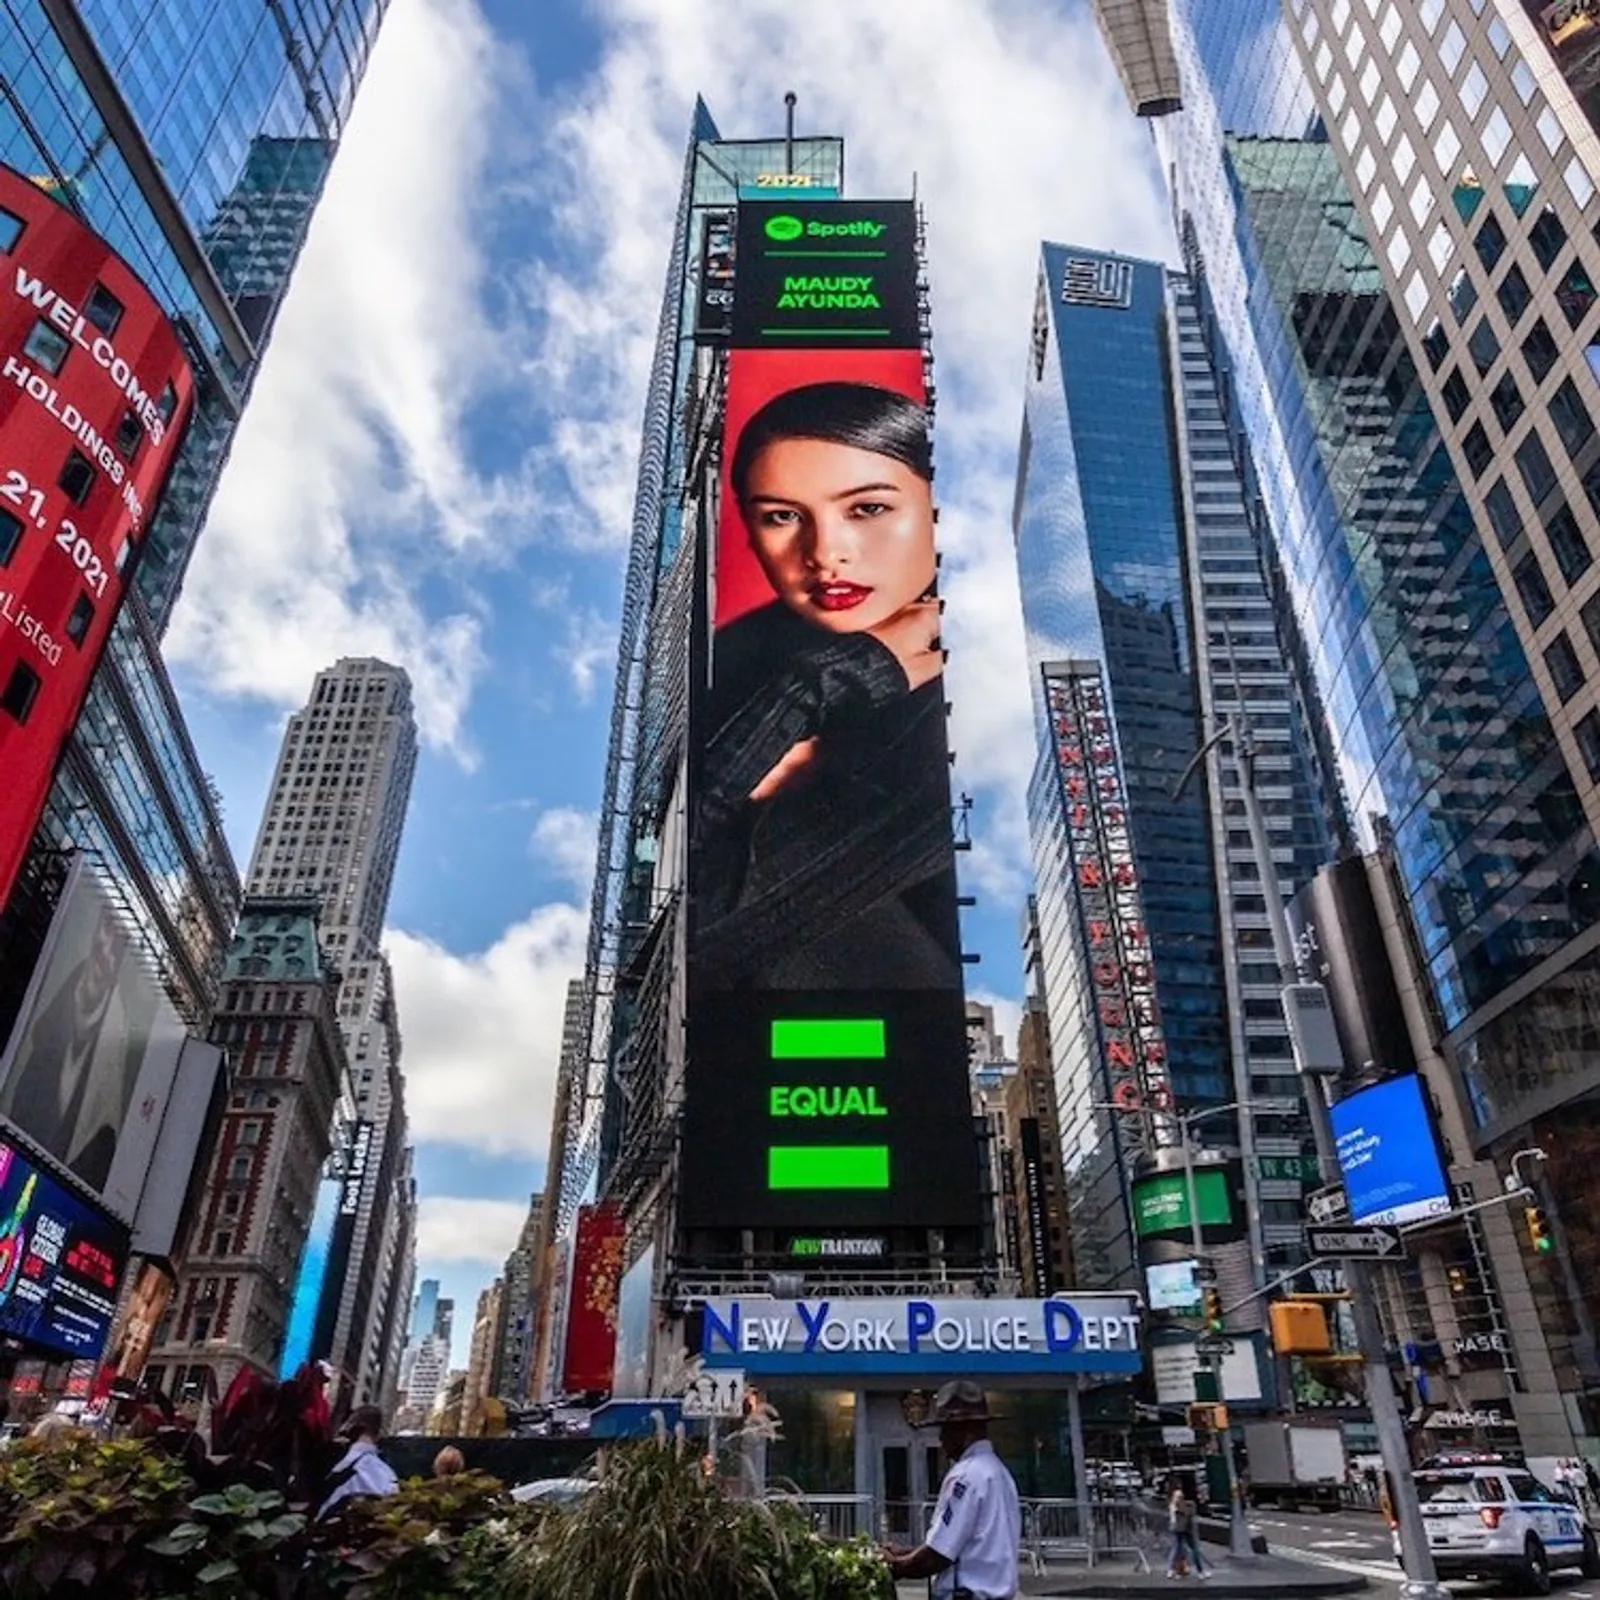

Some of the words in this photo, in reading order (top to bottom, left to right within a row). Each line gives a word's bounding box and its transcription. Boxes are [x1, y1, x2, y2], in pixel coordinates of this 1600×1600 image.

[807, 221, 884, 238] Spotify
[776, 293, 881, 309] AYUNDA
[784, 276, 873, 291] MAUDY
[15, 267, 165, 447] WELCOMES
[2, 356, 125, 485] HOLDINGS
[0, 469, 47, 529] 21,
[54, 518, 109, 599] 2021
[0, 590, 63, 667] Listed
[768, 1086, 888, 1117] EQUAL
[348, 1124, 372, 1176] Locker
[341, 1179, 362, 1215] Foot
[1320, 1236, 1347, 1249] ONE
[1359, 1236, 1388, 1249] WAY
[702, 1301, 790, 1353] NEW
[797, 1301, 896, 1353] YORK
[907, 1301, 1031, 1353] POLICE
[1044, 1300, 1141, 1353] DEPT
[1454, 1334, 1503, 1354] HASE
